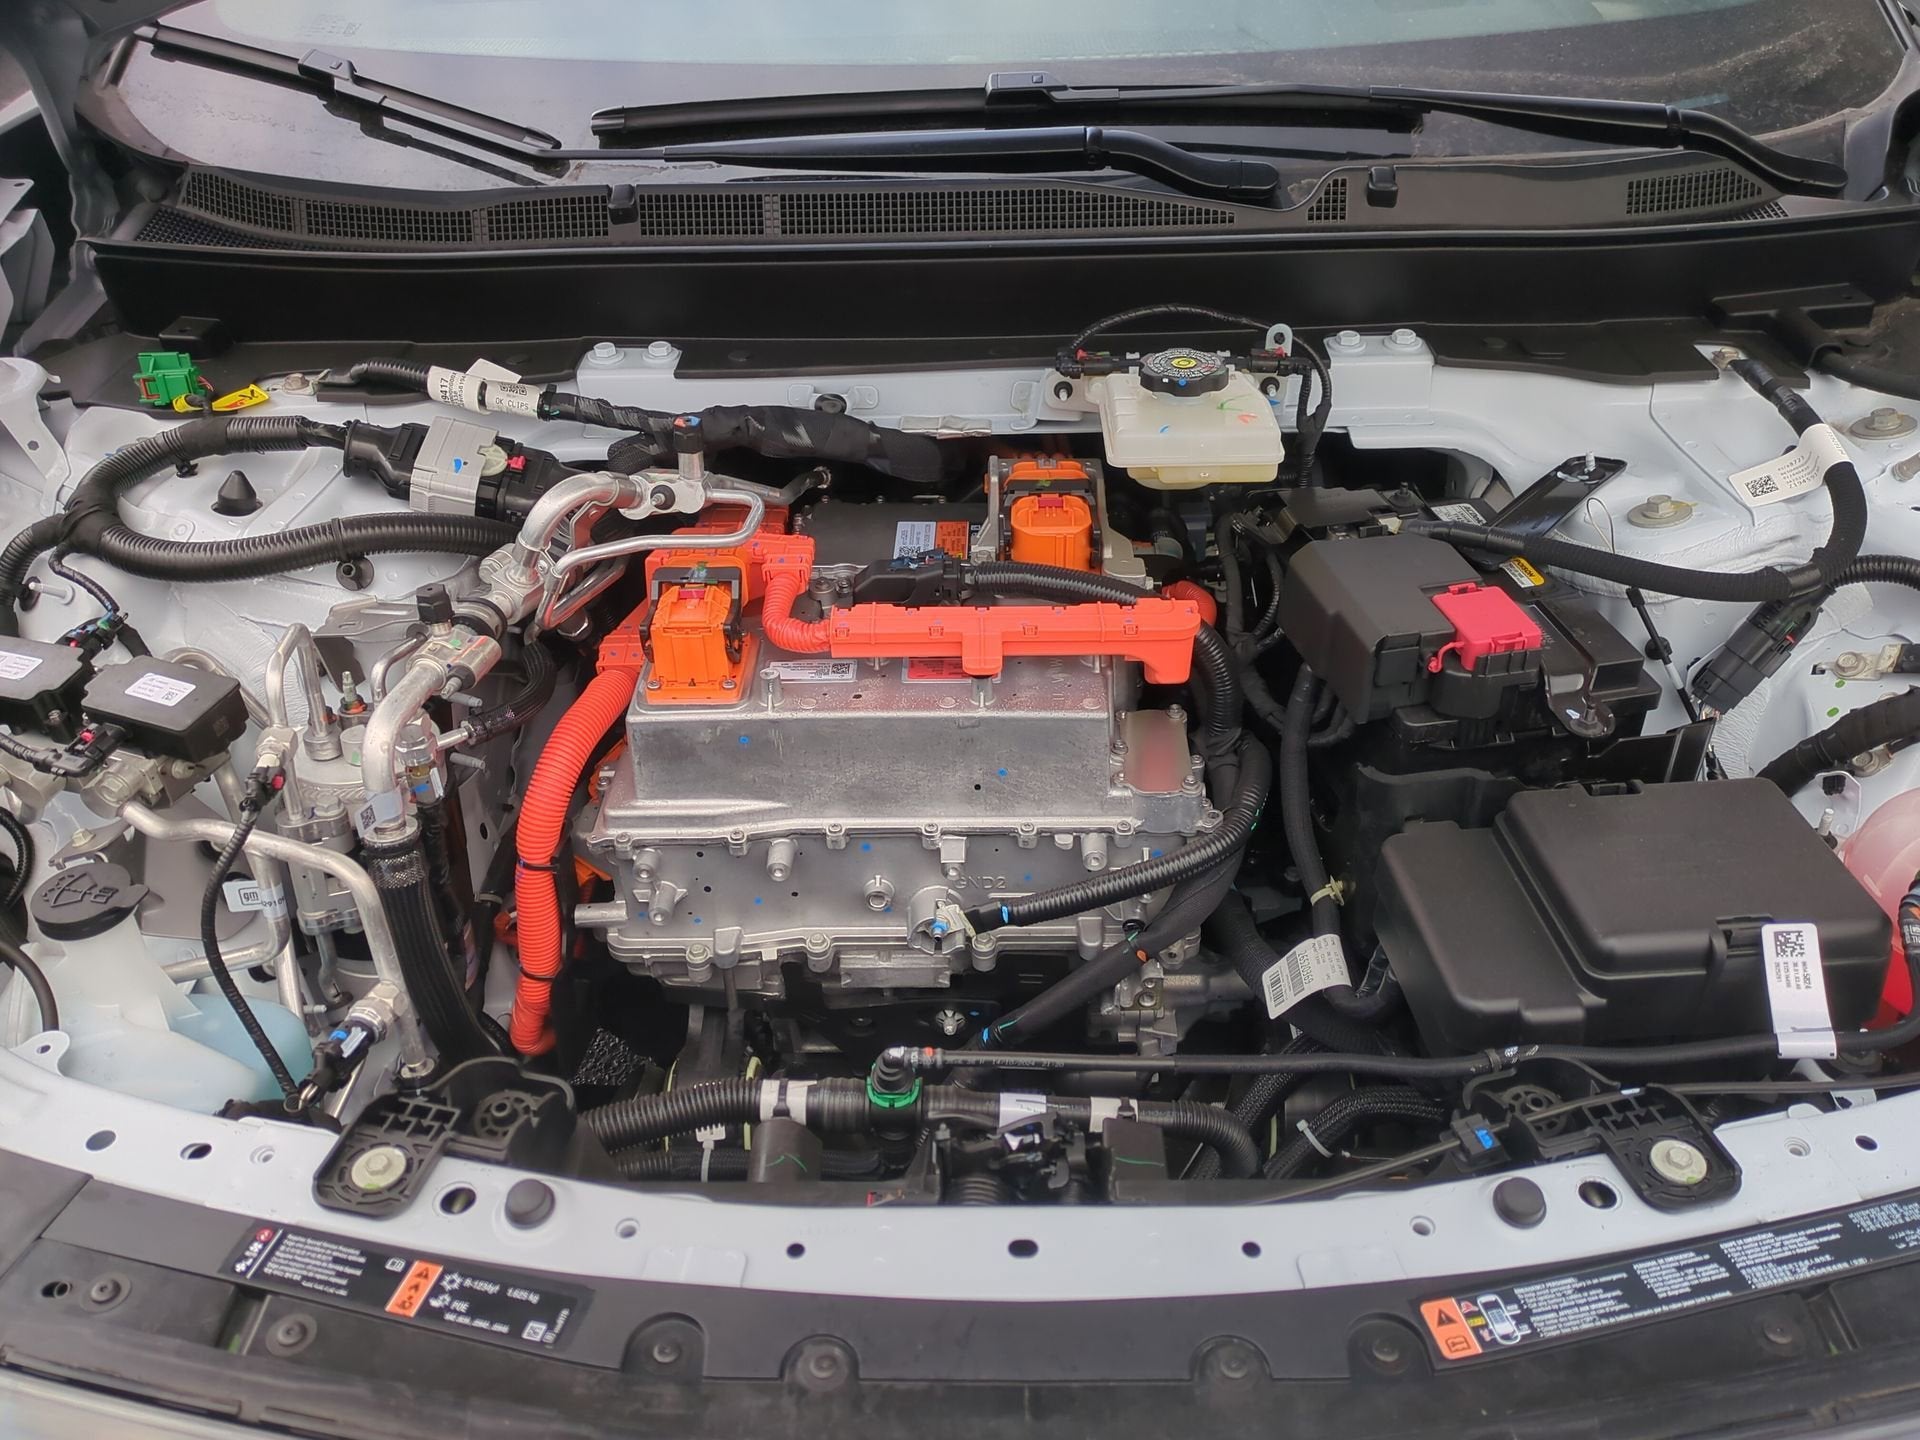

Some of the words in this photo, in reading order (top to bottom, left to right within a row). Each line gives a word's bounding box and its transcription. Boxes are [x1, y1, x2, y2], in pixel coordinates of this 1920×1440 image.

[495, 398, 504, 406] OK
[507, 399, 529, 410] CLIPS
[953, 875, 1006, 889] GND2
[243, 891, 259, 901] gm
